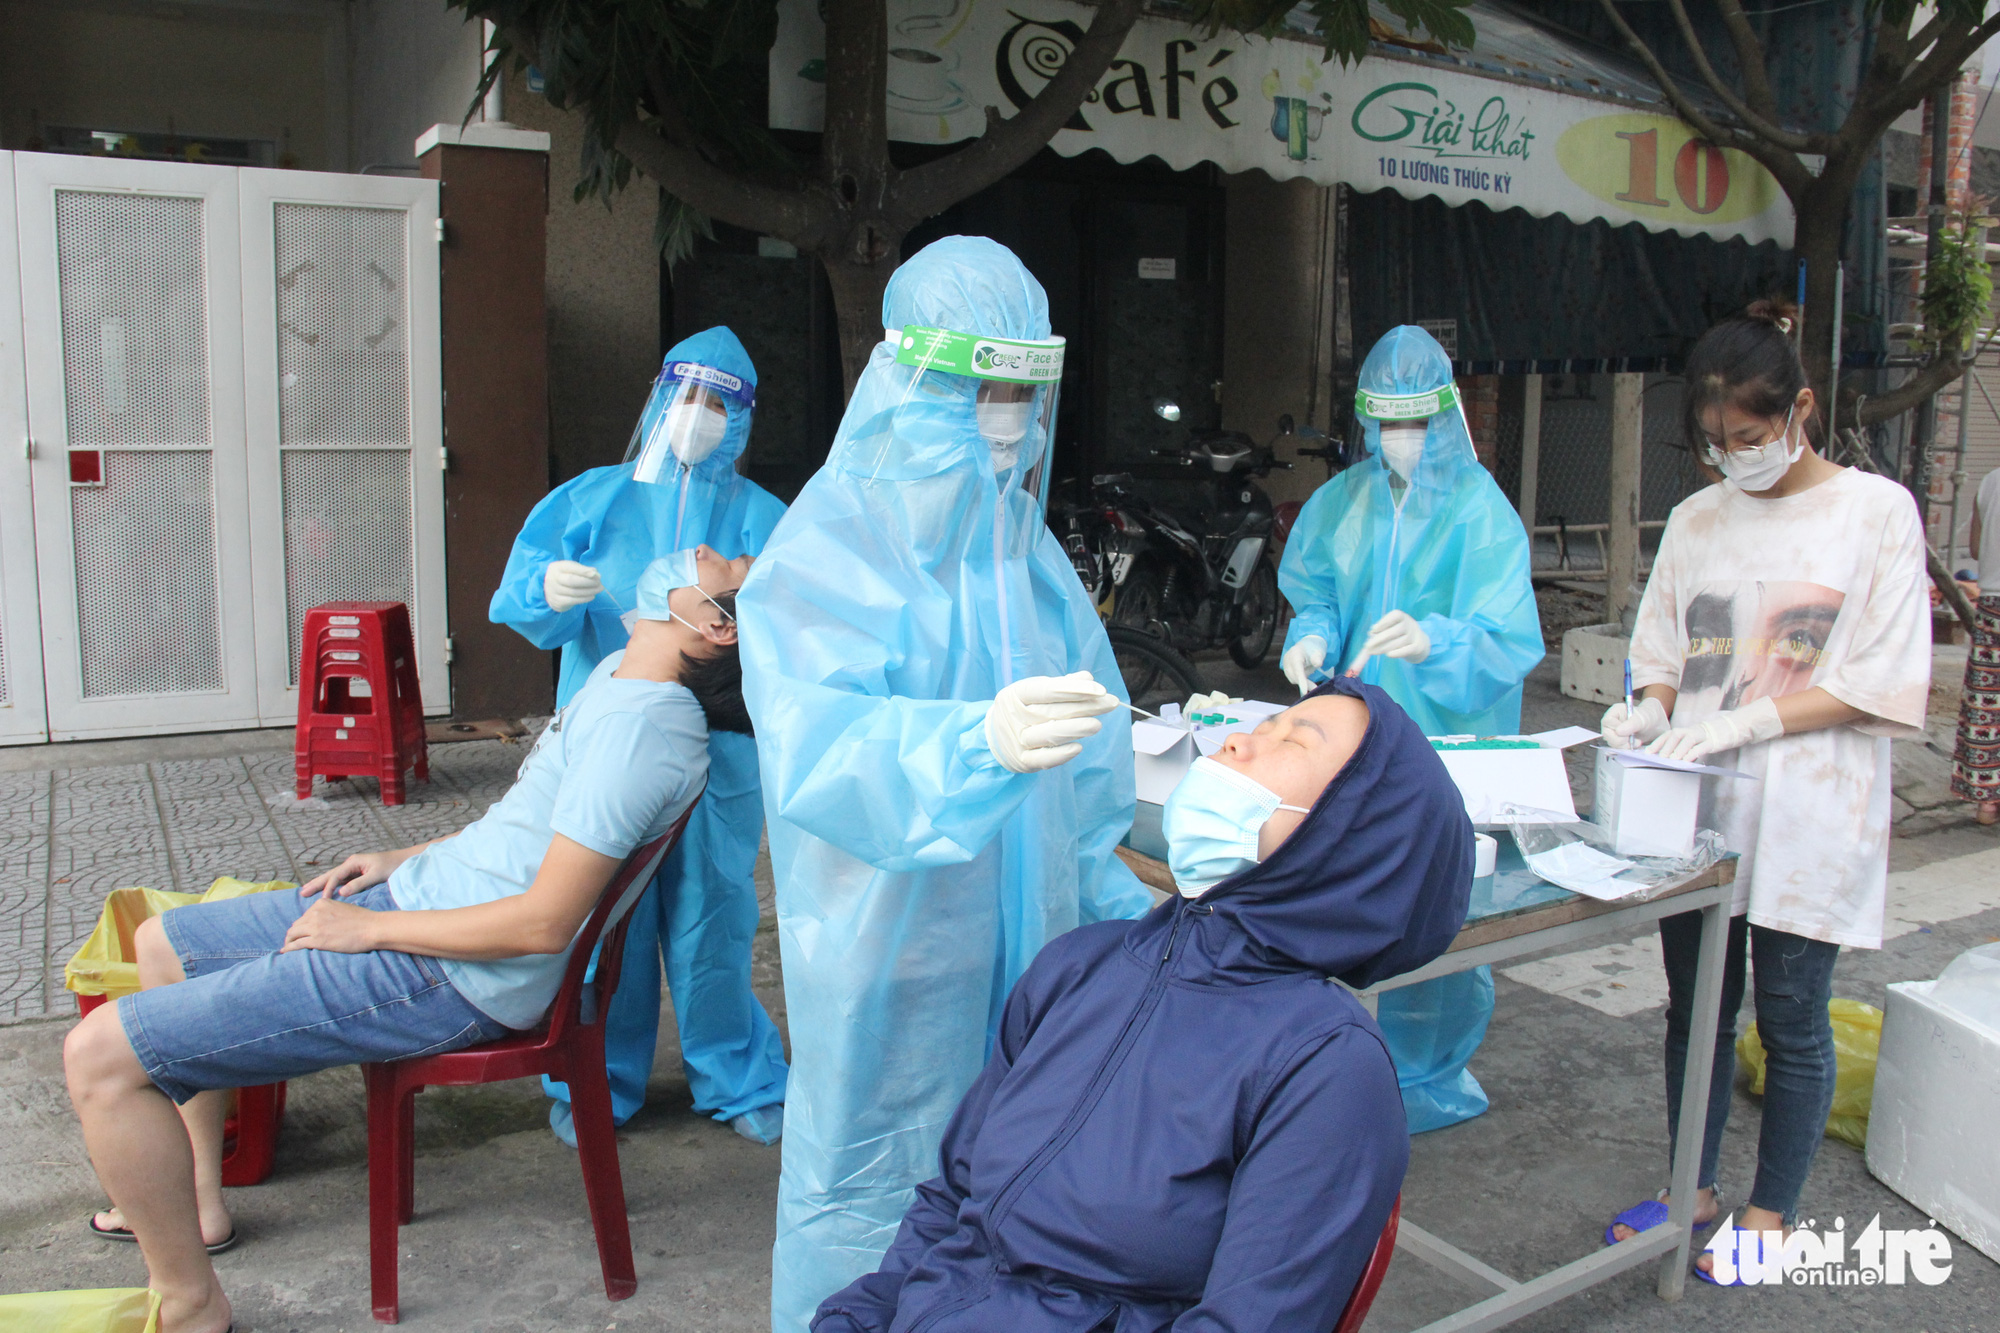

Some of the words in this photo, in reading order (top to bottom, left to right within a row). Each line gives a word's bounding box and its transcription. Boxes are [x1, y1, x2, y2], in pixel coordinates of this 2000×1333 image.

[1351, 81, 1462, 147] Giải
[1468, 95, 1535, 162] khát
[1378, 156, 1397, 178] 10
[1401, 160, 1449, 185] LƯƠNG
[1453, 167, 1490, 191] THÚC
[1494, 172, 1511, 194] KỲ
[1614, 127, 1730, 214] 10
[933, 358, 956, 368] Vietnam
[1025, 350, 1051, 364] Face
[677, 365, 701, 376] Face
[704, 370, 738, 388] Shield
[1029, 368, 1049, 377] GREEN
[1389, 401, 1410, 409] Face
[1412, 396, 1438, 408] Shield
[1711, 637, 1734, 655] THE
